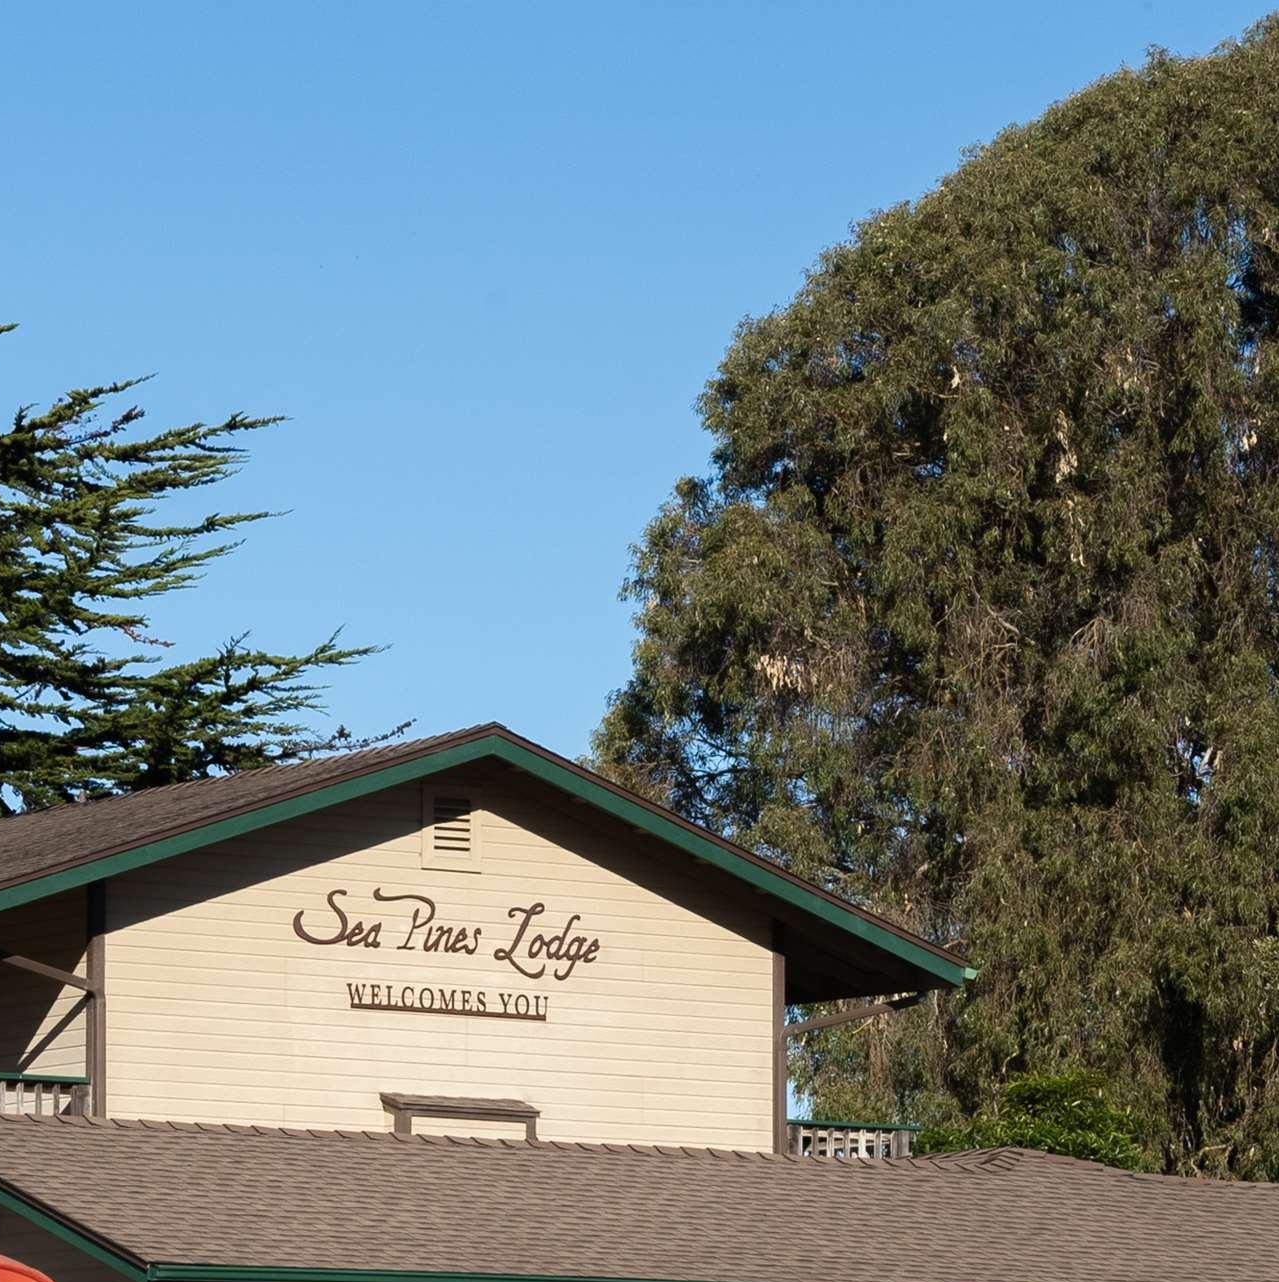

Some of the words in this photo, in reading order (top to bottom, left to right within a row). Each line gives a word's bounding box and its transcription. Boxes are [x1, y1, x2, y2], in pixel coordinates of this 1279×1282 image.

[293, 889, 381, 948] Sea
[373, 887, 482, 955] Pines
[494, 902, 601, 980] Lodge
[346, 982, 488, 1013] WELCOMES
[498, 992, 550, 1017] YOU
